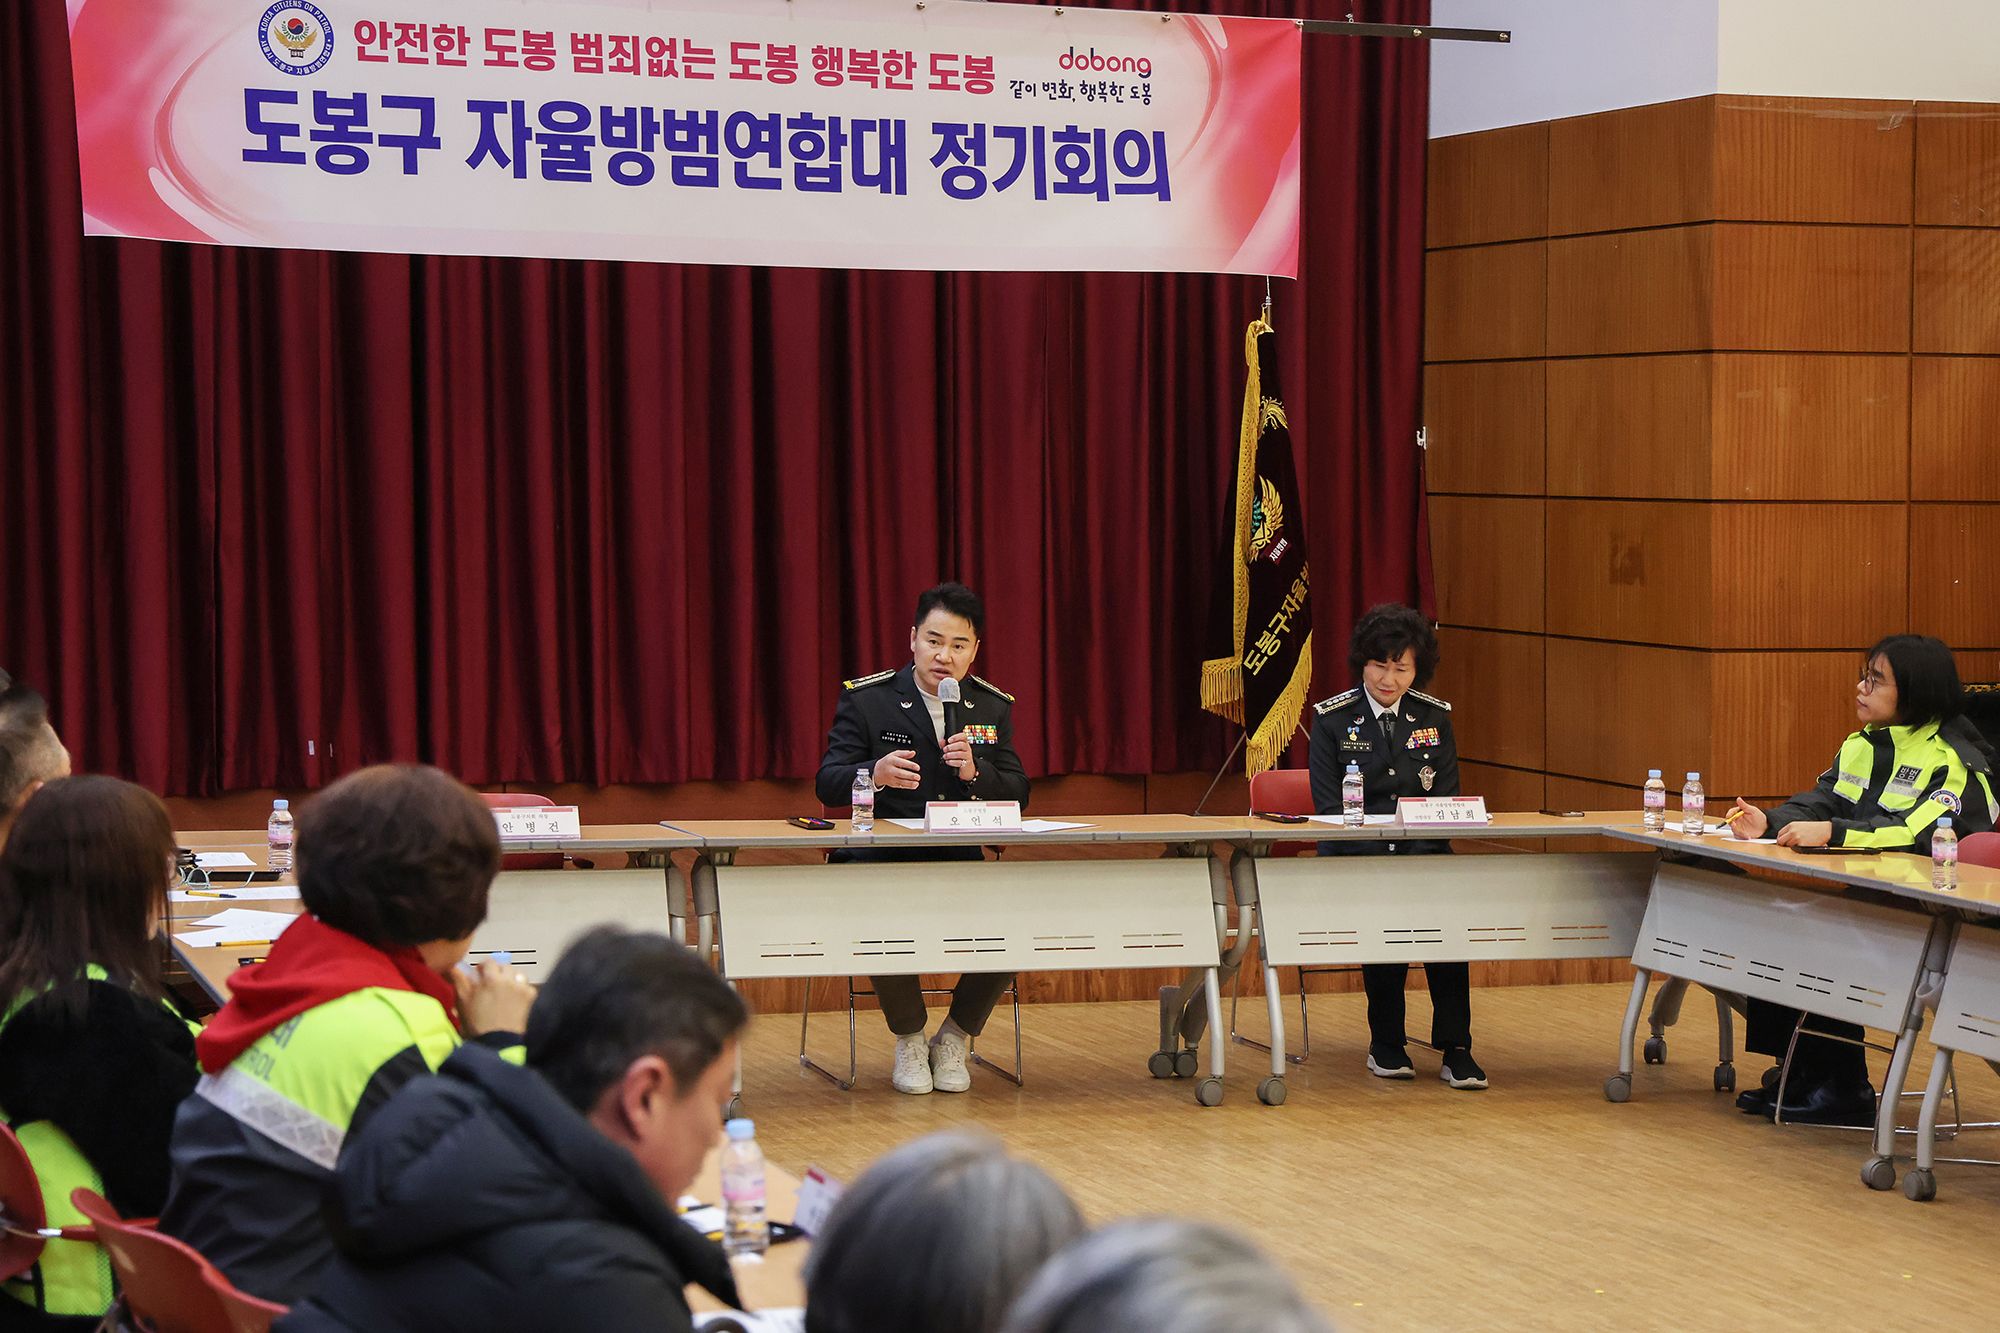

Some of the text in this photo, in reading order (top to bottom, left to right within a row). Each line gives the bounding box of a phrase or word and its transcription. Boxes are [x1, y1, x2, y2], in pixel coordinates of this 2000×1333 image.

[261, 0, 332, 34] KOREA CITIZENS ON PATROL
[355, 20, 996, 95] 안전한 도봉 범죄없는 도봉 행복한 도봉
[1058, 46, 1152, 79] dobong
[1009, 78, 1152, 106] 같이 변화, 행복한 도봉
[243, 88, 1171, 202] 도봉구 자율방범연합대 정기회의
[1898, 766, 1919, 781] 방범
[502, 820, 560, 834] 안병건
